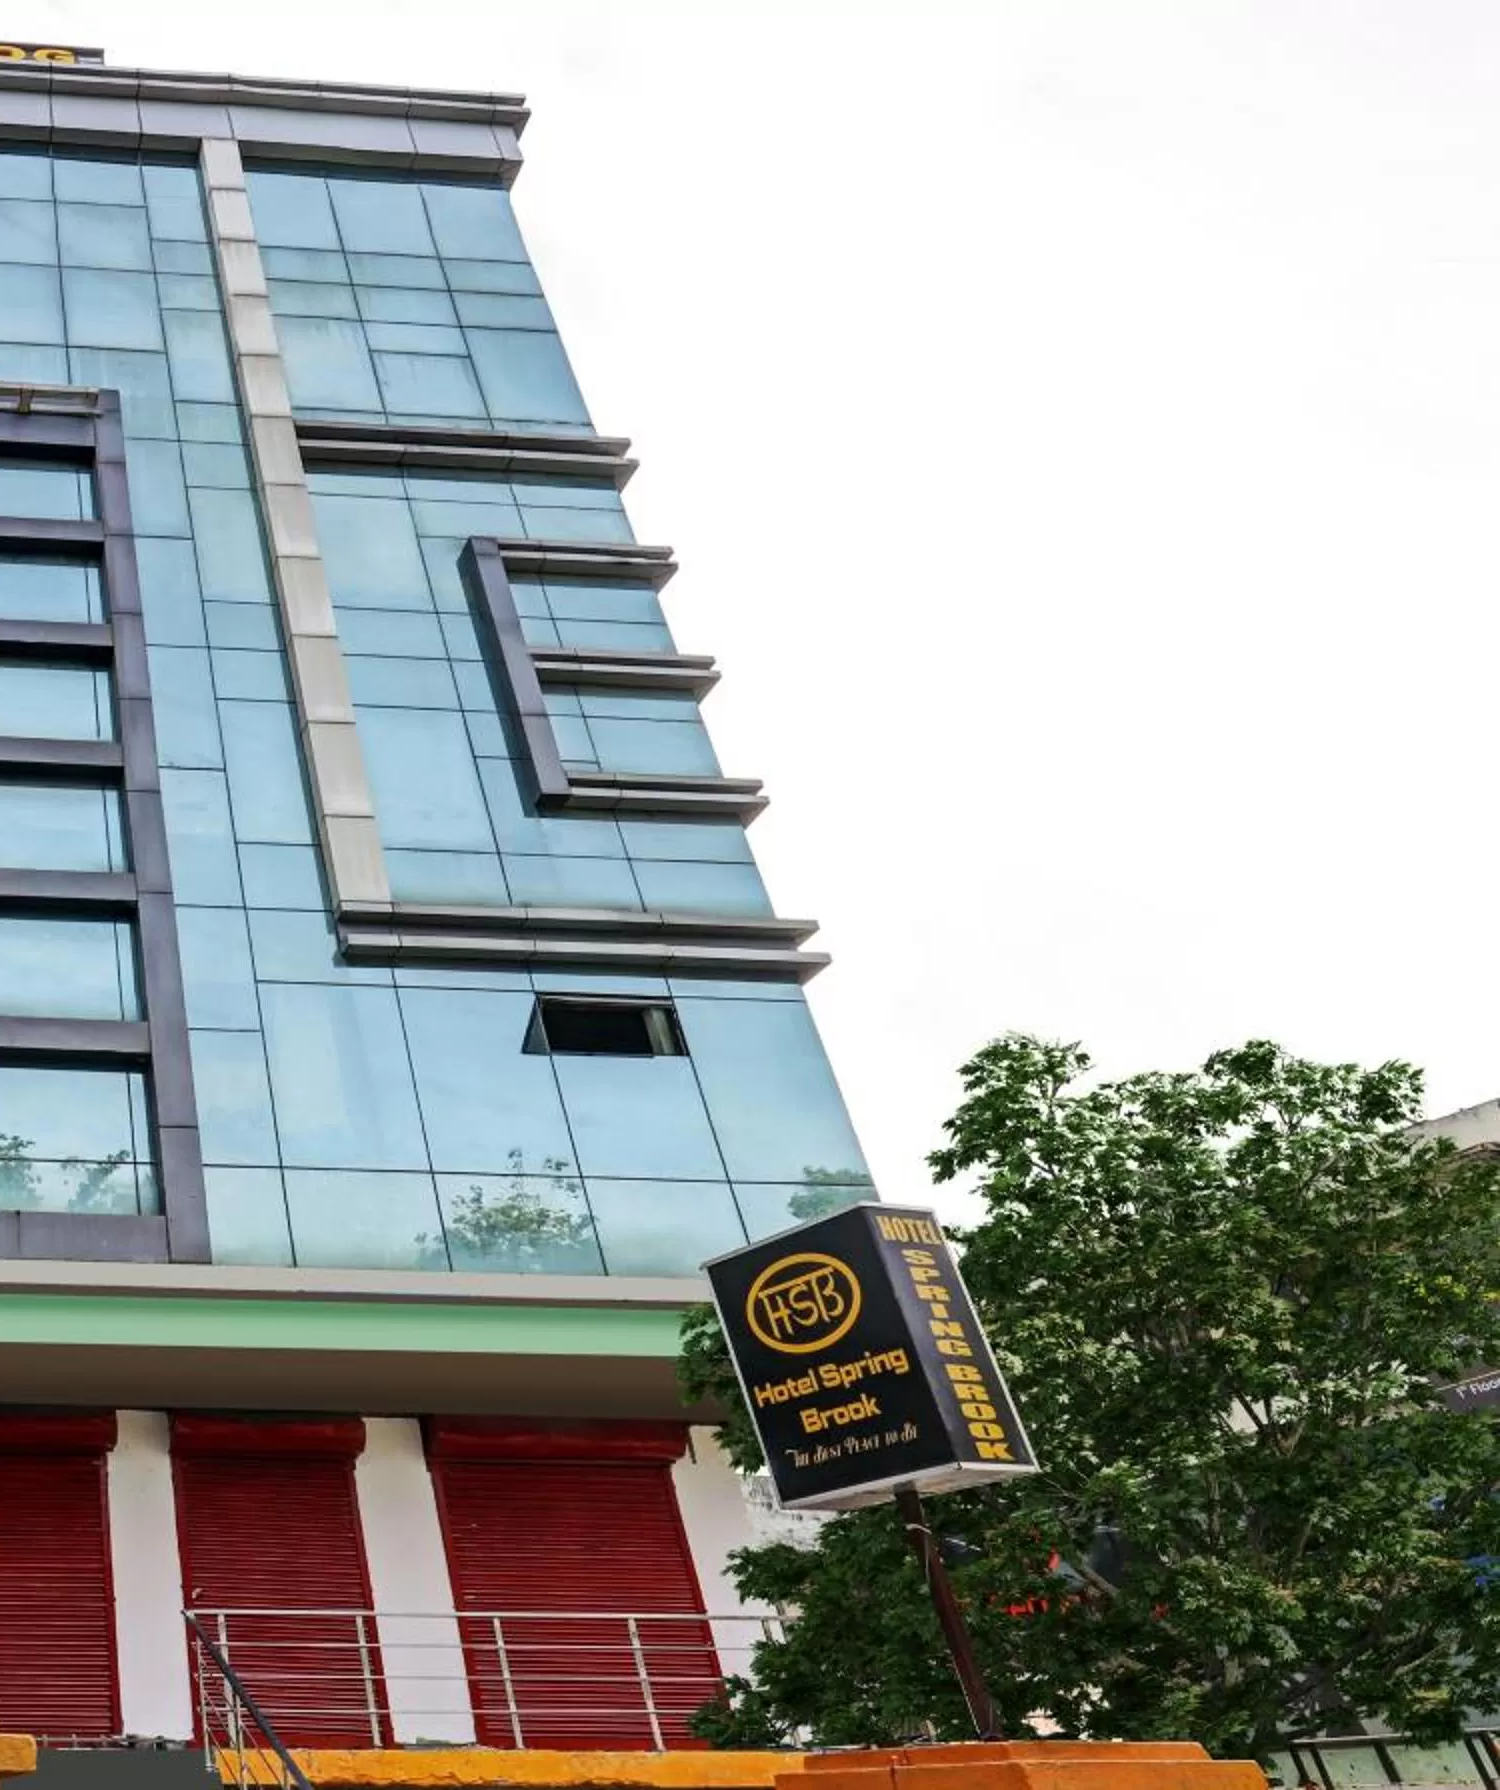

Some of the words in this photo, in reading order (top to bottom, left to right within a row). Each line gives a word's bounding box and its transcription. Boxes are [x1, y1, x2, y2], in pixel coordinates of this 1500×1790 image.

[875, 1215, 941, 1246] HOTEL
[902, 1249, 973, 1358] SPRING
[753, 1369, 818, 1408] Hotel
[820, 1349, 910, 1389] Spring
[801, 1394, 882, 1434] Brook
[946, 1363, 1016, 1461] BROOK
